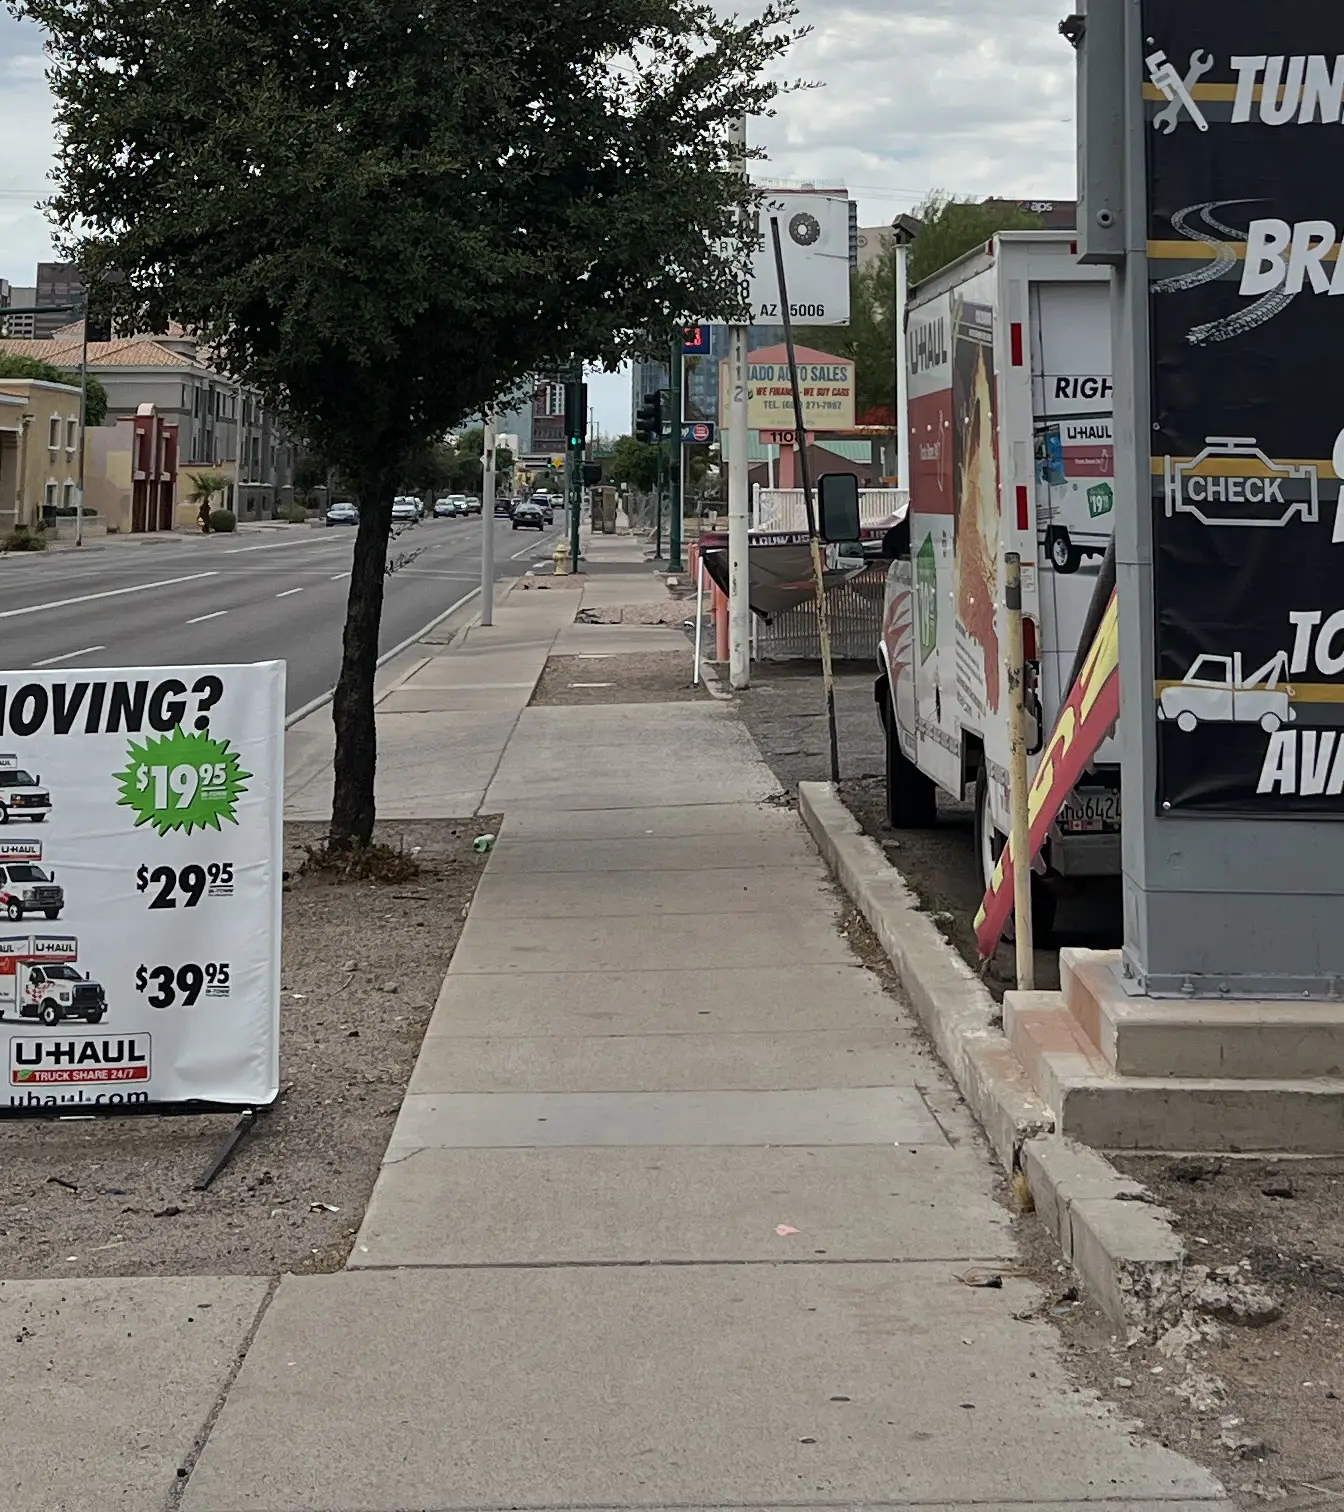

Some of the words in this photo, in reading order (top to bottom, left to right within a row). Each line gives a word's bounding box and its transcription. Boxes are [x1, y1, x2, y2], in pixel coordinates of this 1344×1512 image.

[1030, 202, 1053, 213] aps
[760, 304, 778, 317] AZ
[782, 304, 825, 317] 5006
[910, 316, 948, 375] U-HAUL
[777, 366, 808, 381] AUO
[810, 365, 848, 382] SALES
[1054, 376, 1114, 399] RIGH
[1067, 424, 1112, 439] U-HAUL
[1187, 476, 1285, 505] CHECK
[35, 941, 74, 953] U-HAUL
[15, 1039, 146, 1065] U-HAUL
[34, 1071, 70, 1082] TRUCK
[72, 1070, 109, 1081] SHARE
[110, 1069, 134, 1080] 24/7
